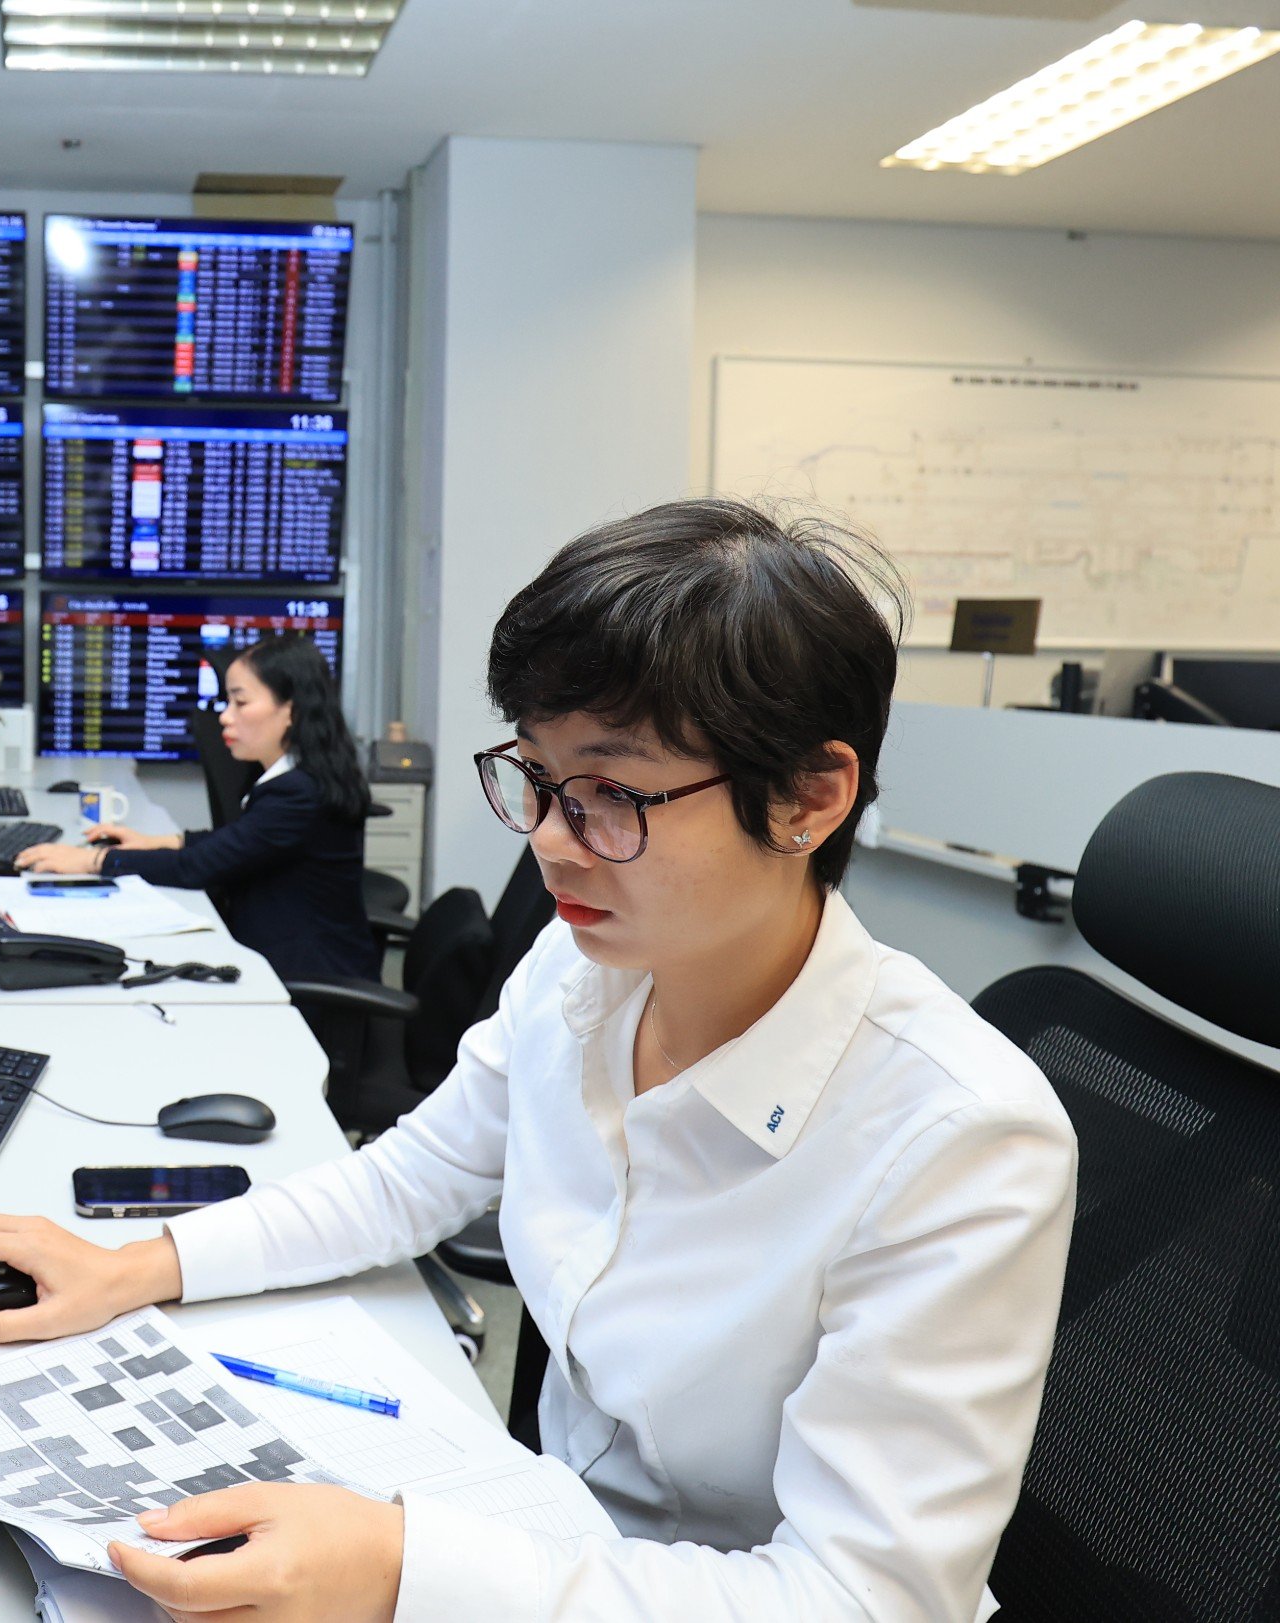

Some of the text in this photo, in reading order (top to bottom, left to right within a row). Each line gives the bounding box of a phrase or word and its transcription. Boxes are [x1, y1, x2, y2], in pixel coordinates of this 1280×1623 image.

[290, 413, 334, 430] 11:36
[286, 600, 329, 617] 11:36
[766, 1104, 785, 1133] ACV
